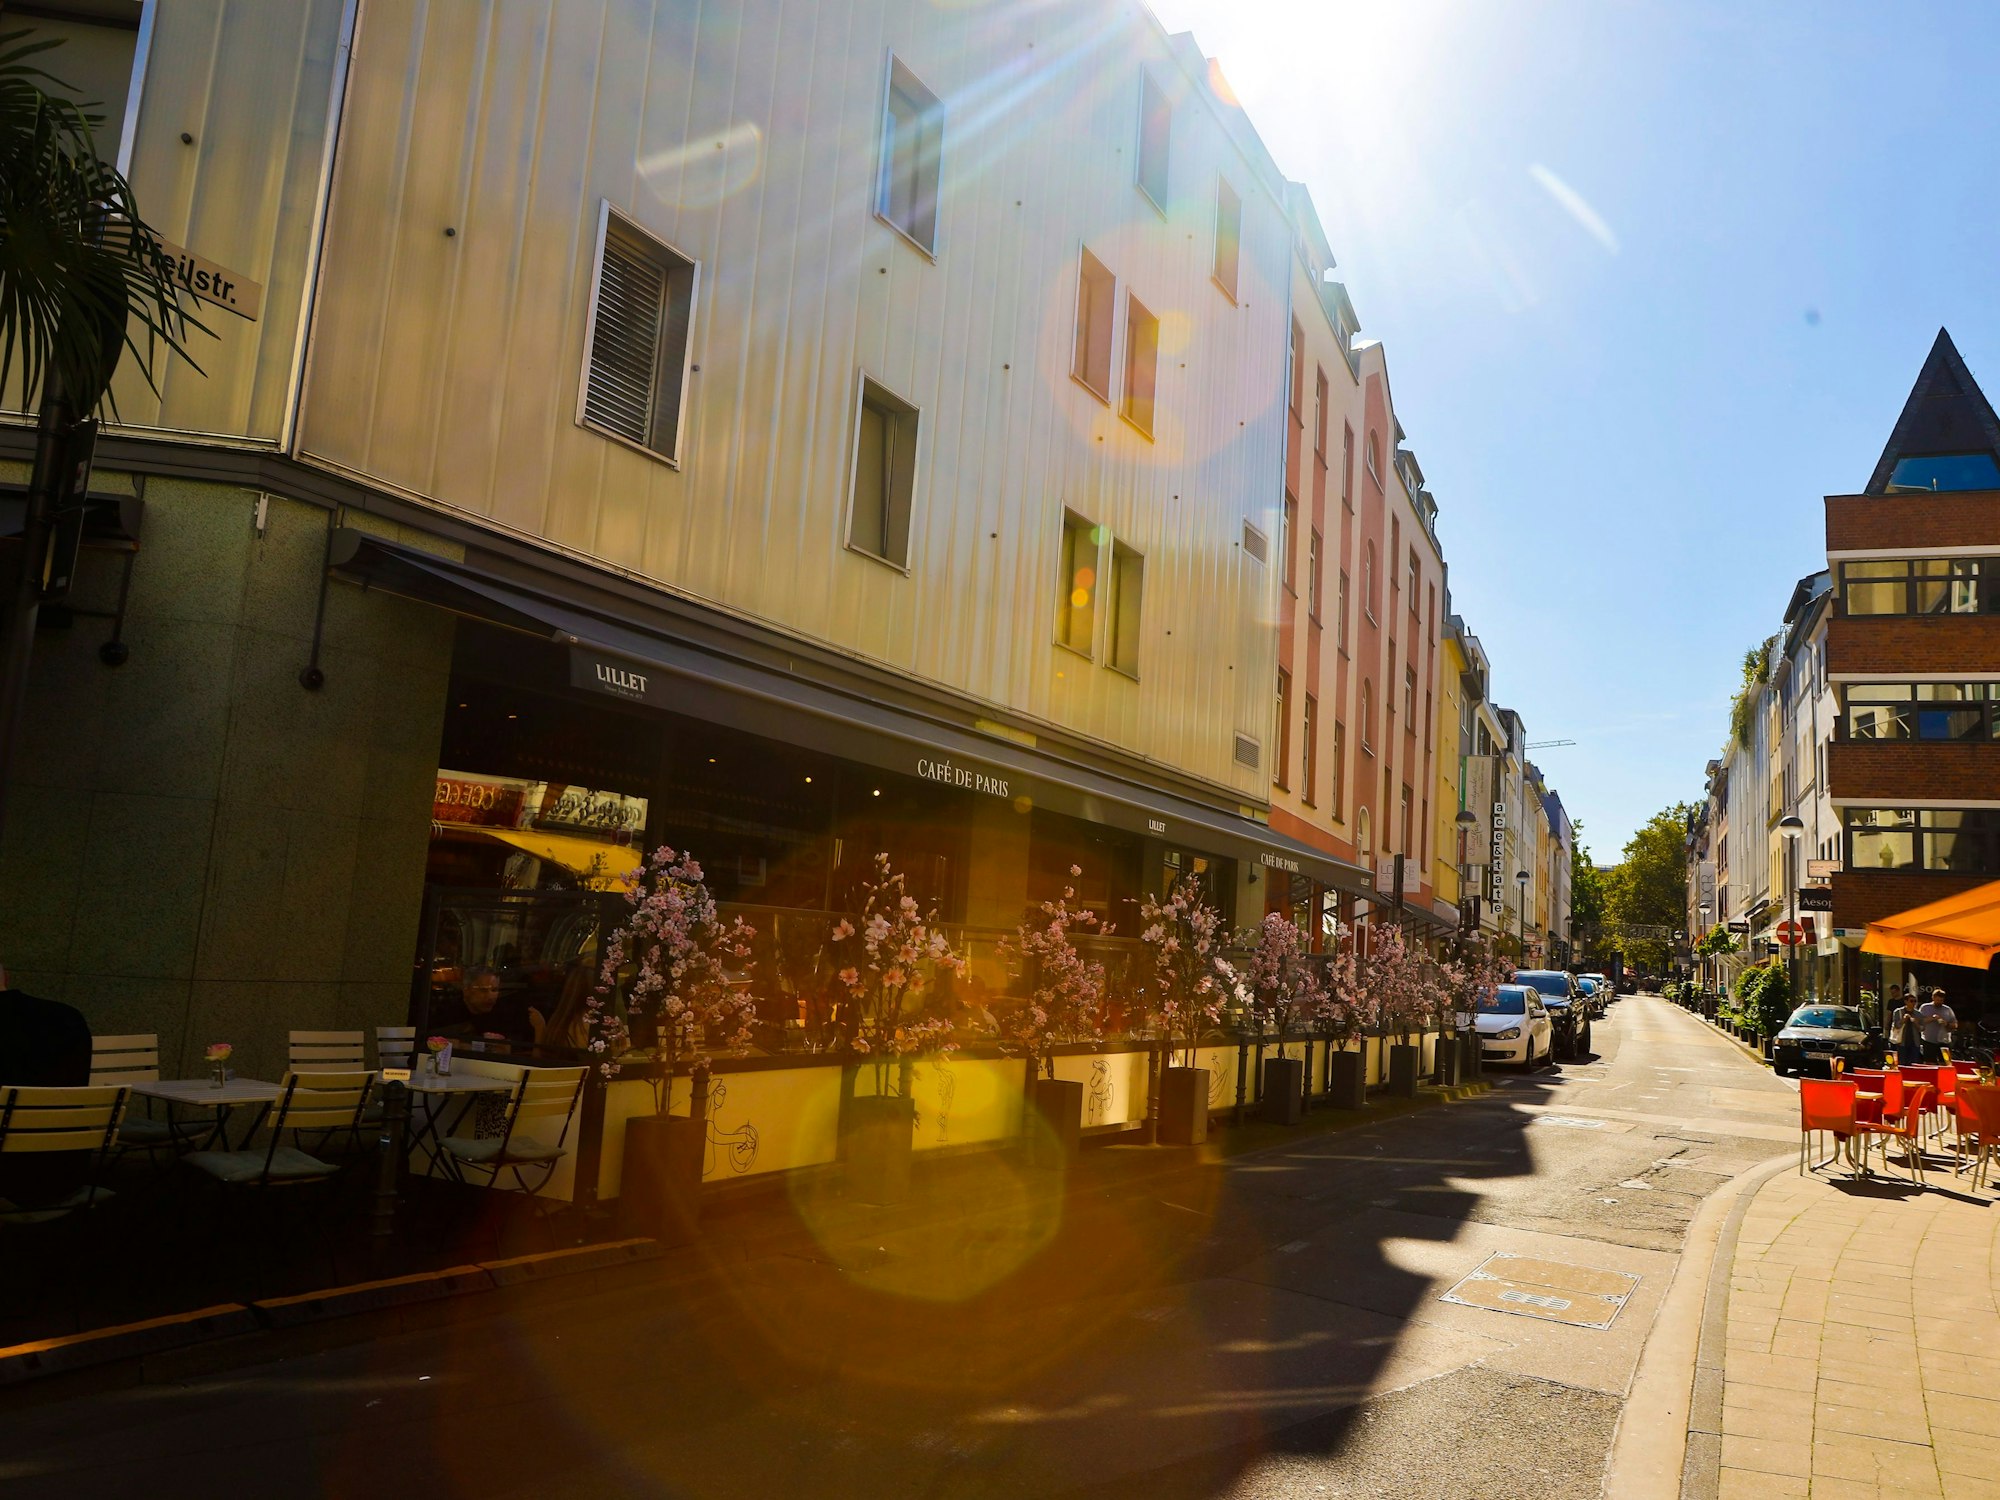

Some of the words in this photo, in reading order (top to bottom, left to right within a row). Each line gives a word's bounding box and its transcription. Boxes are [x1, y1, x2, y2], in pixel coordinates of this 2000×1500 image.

[595, 663, 648, 693] LILLET
[917, 758, 952, 783] CAFÉ
[955, 767, 973, 788] DE
[975, 773, 1009, 797] PARIS
[1149, 818, 1166, 833] LILLET
[1260, 851, 1275, 867] CAFÉ
[1275, 856, 1284, 870] DE
[1284, 858, 1299, 873] PARIS
